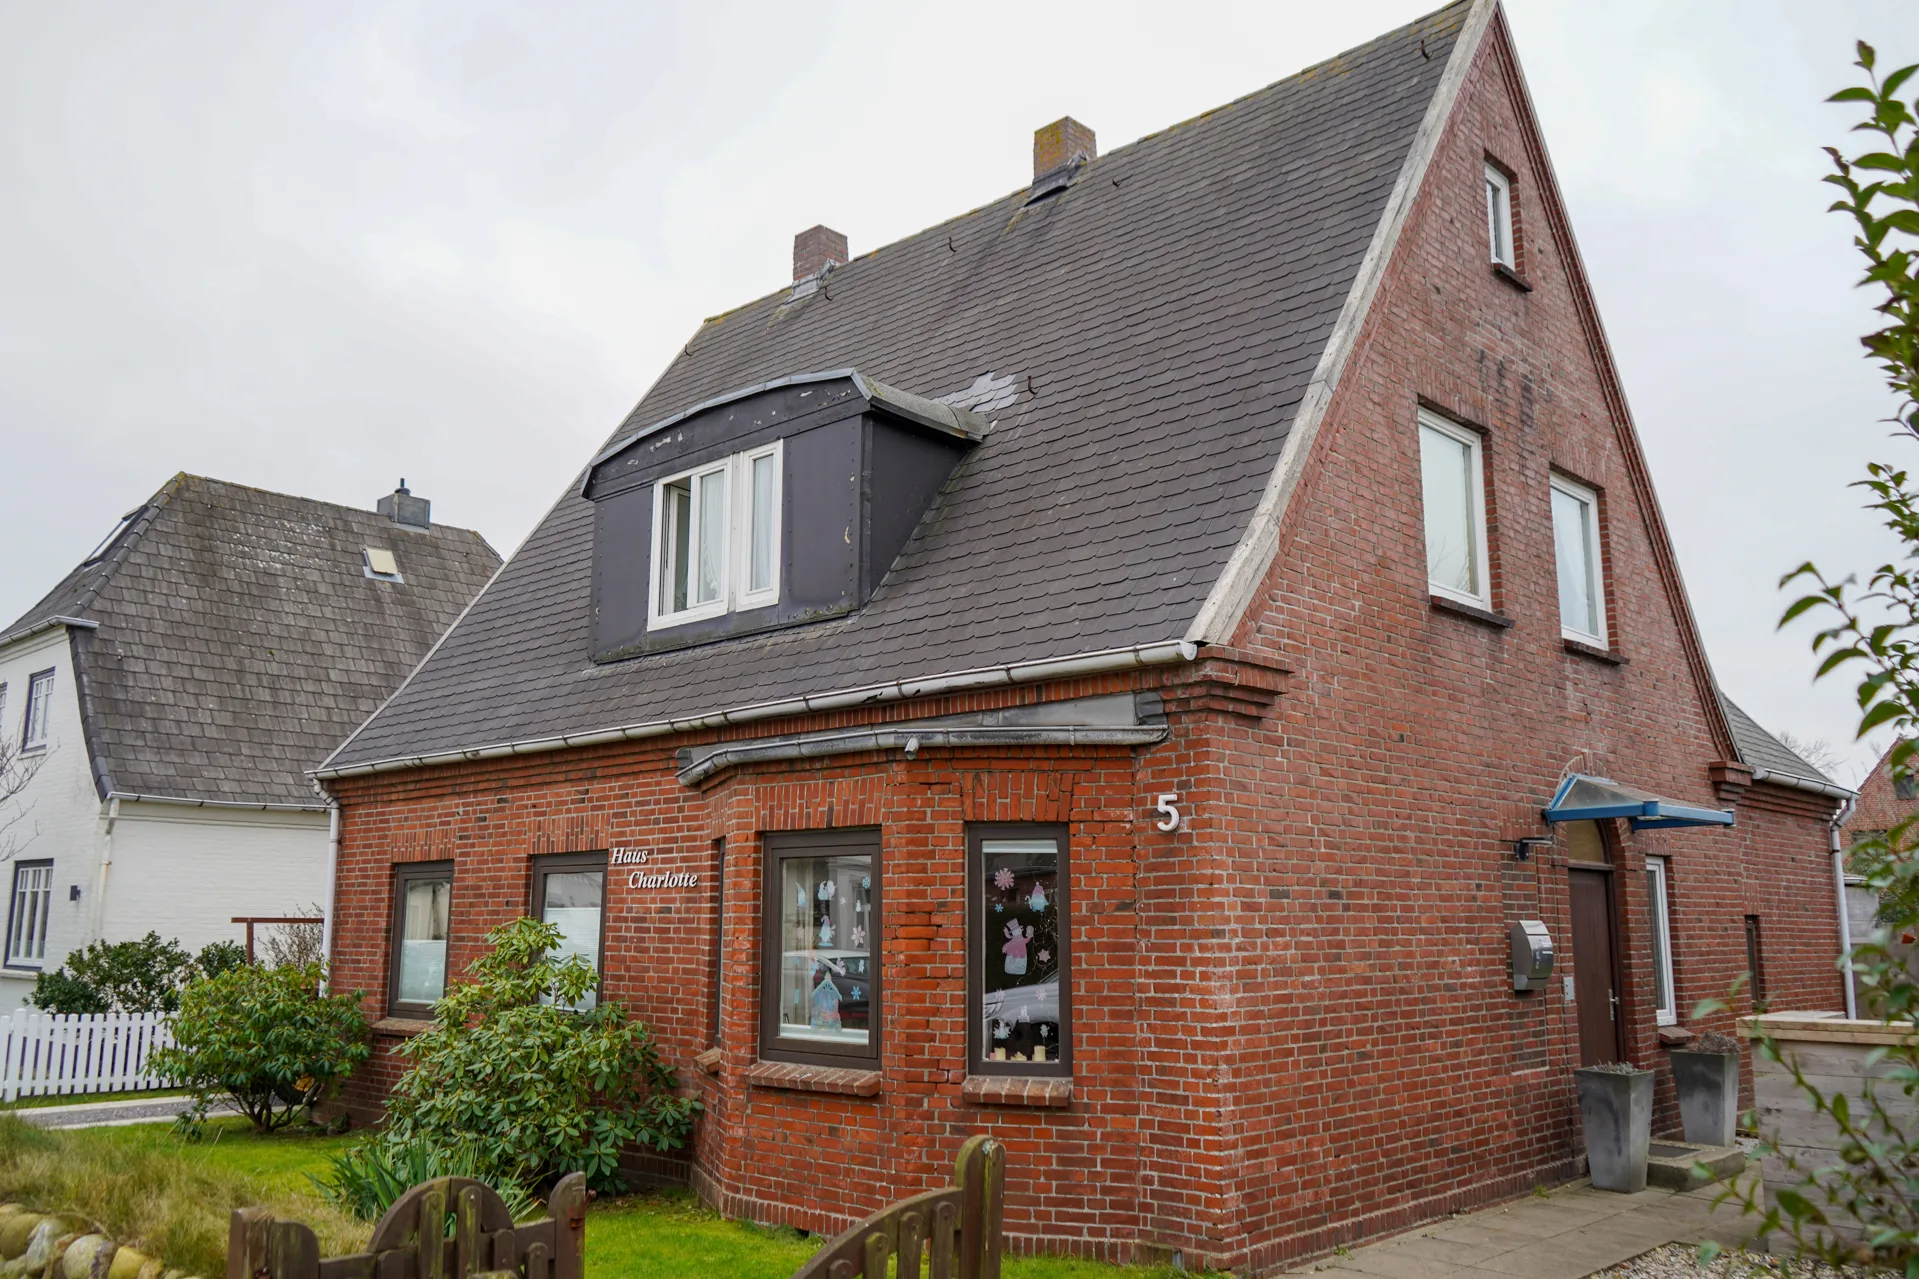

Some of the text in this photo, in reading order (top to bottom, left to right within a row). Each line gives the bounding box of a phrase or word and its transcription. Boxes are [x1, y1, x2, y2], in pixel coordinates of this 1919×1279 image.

[1157, 794, 1180, 831] 5
[610, 847, 649, 865] Haus
[628, 870, 698, 889] Charlotte
